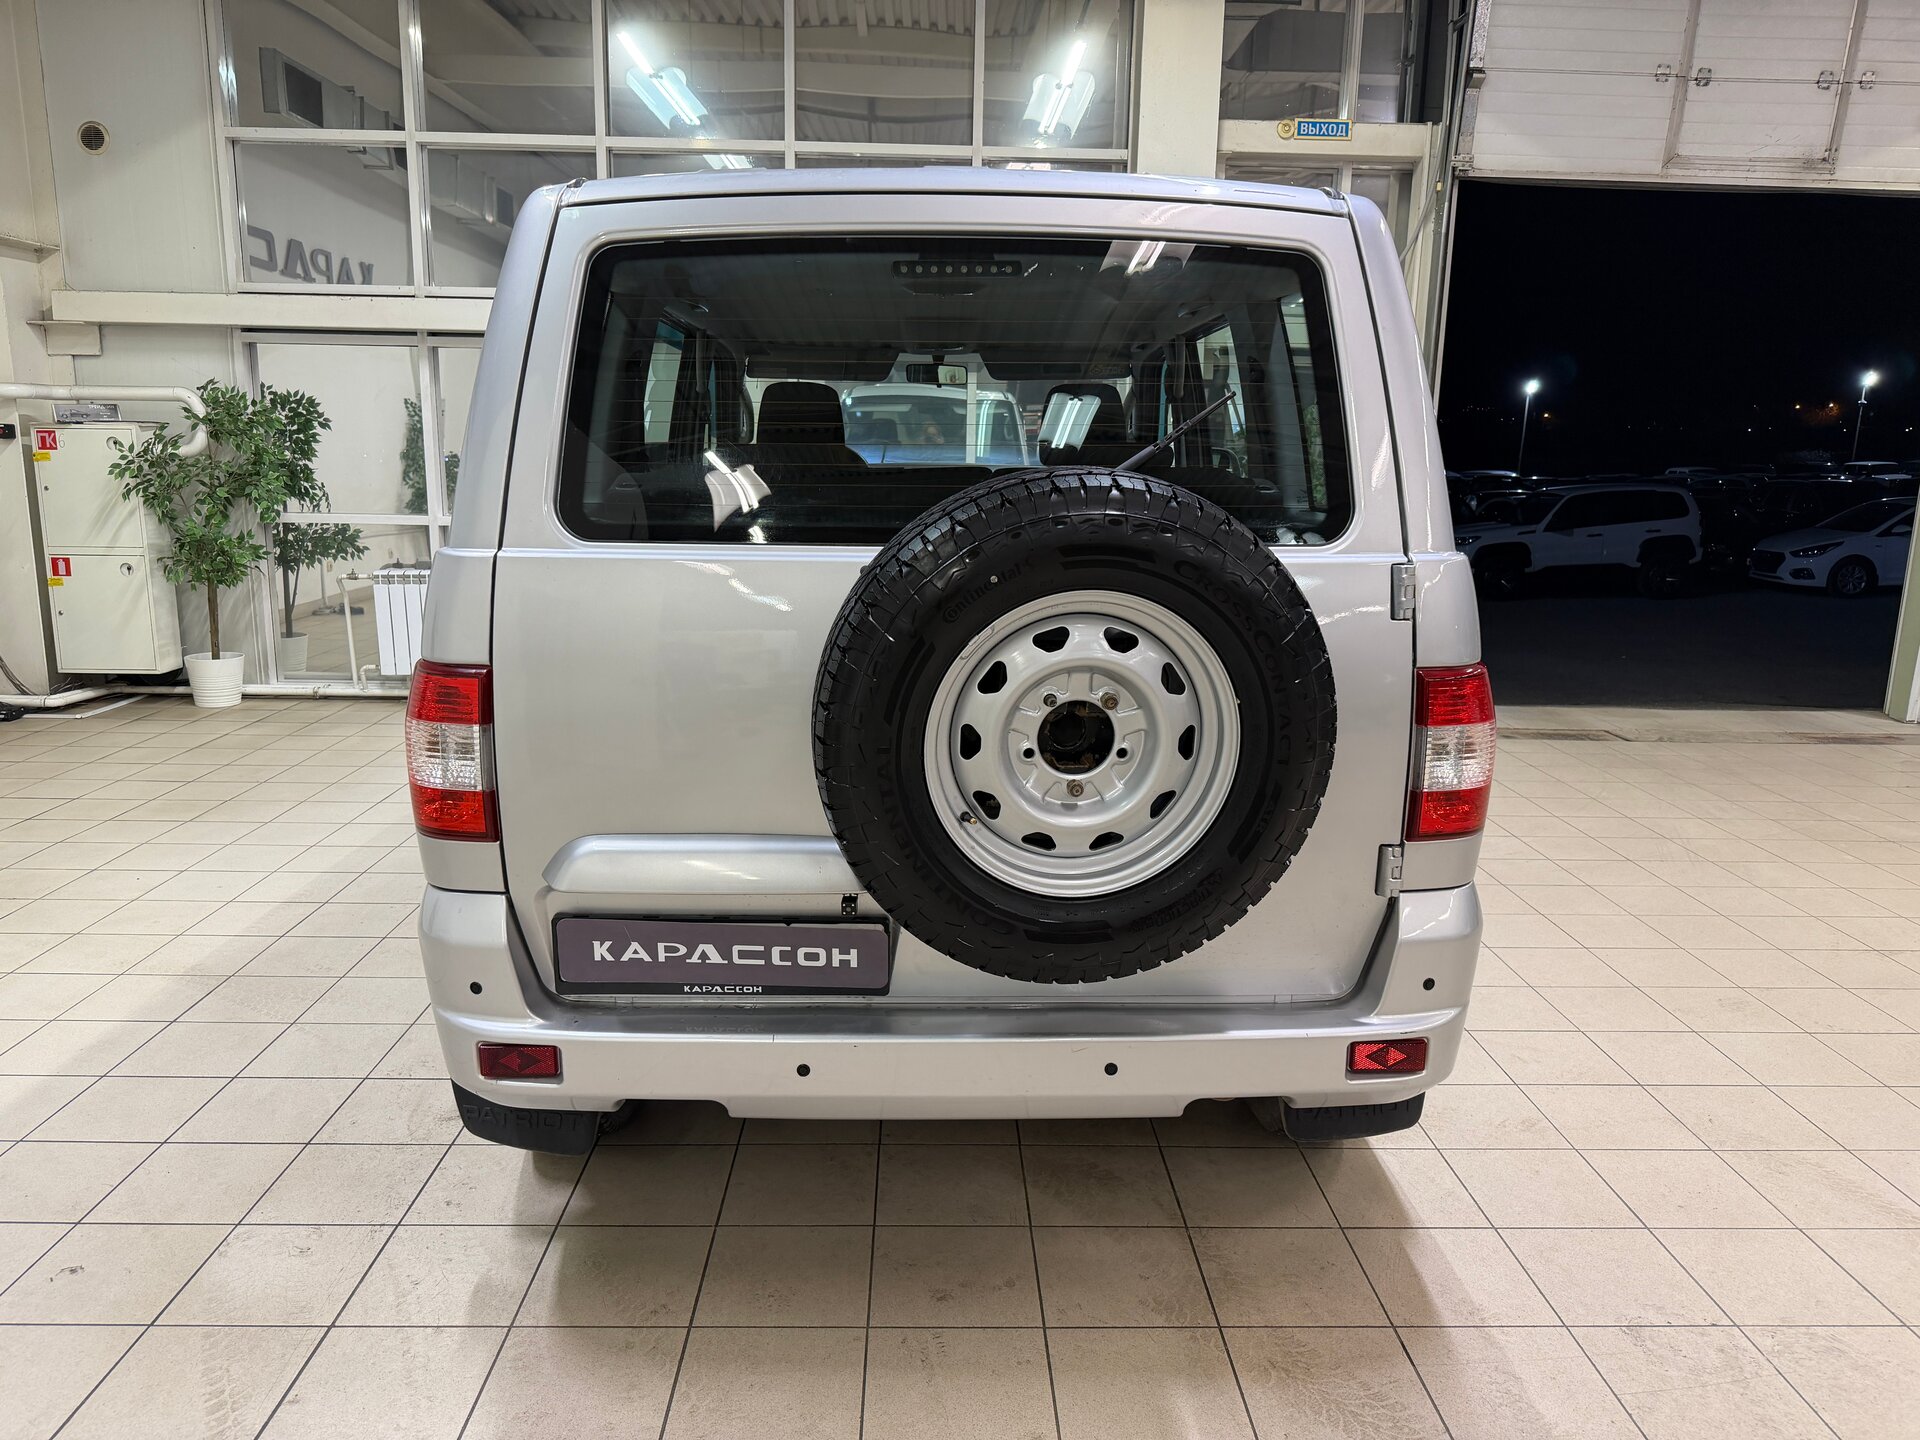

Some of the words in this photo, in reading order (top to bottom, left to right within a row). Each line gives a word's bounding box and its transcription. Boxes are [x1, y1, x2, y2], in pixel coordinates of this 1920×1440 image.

[1299, 123, 1346, 137] ВЫХОД
[37, 432, 57, 448] ПК
[942, 561, 1021, 624] Continetal
[591, 940, 858, 968] КАРАССОН
[683, 984, 763, 994] КАРАССОН
[462, 1104, 585, 1131] PATRIOT
